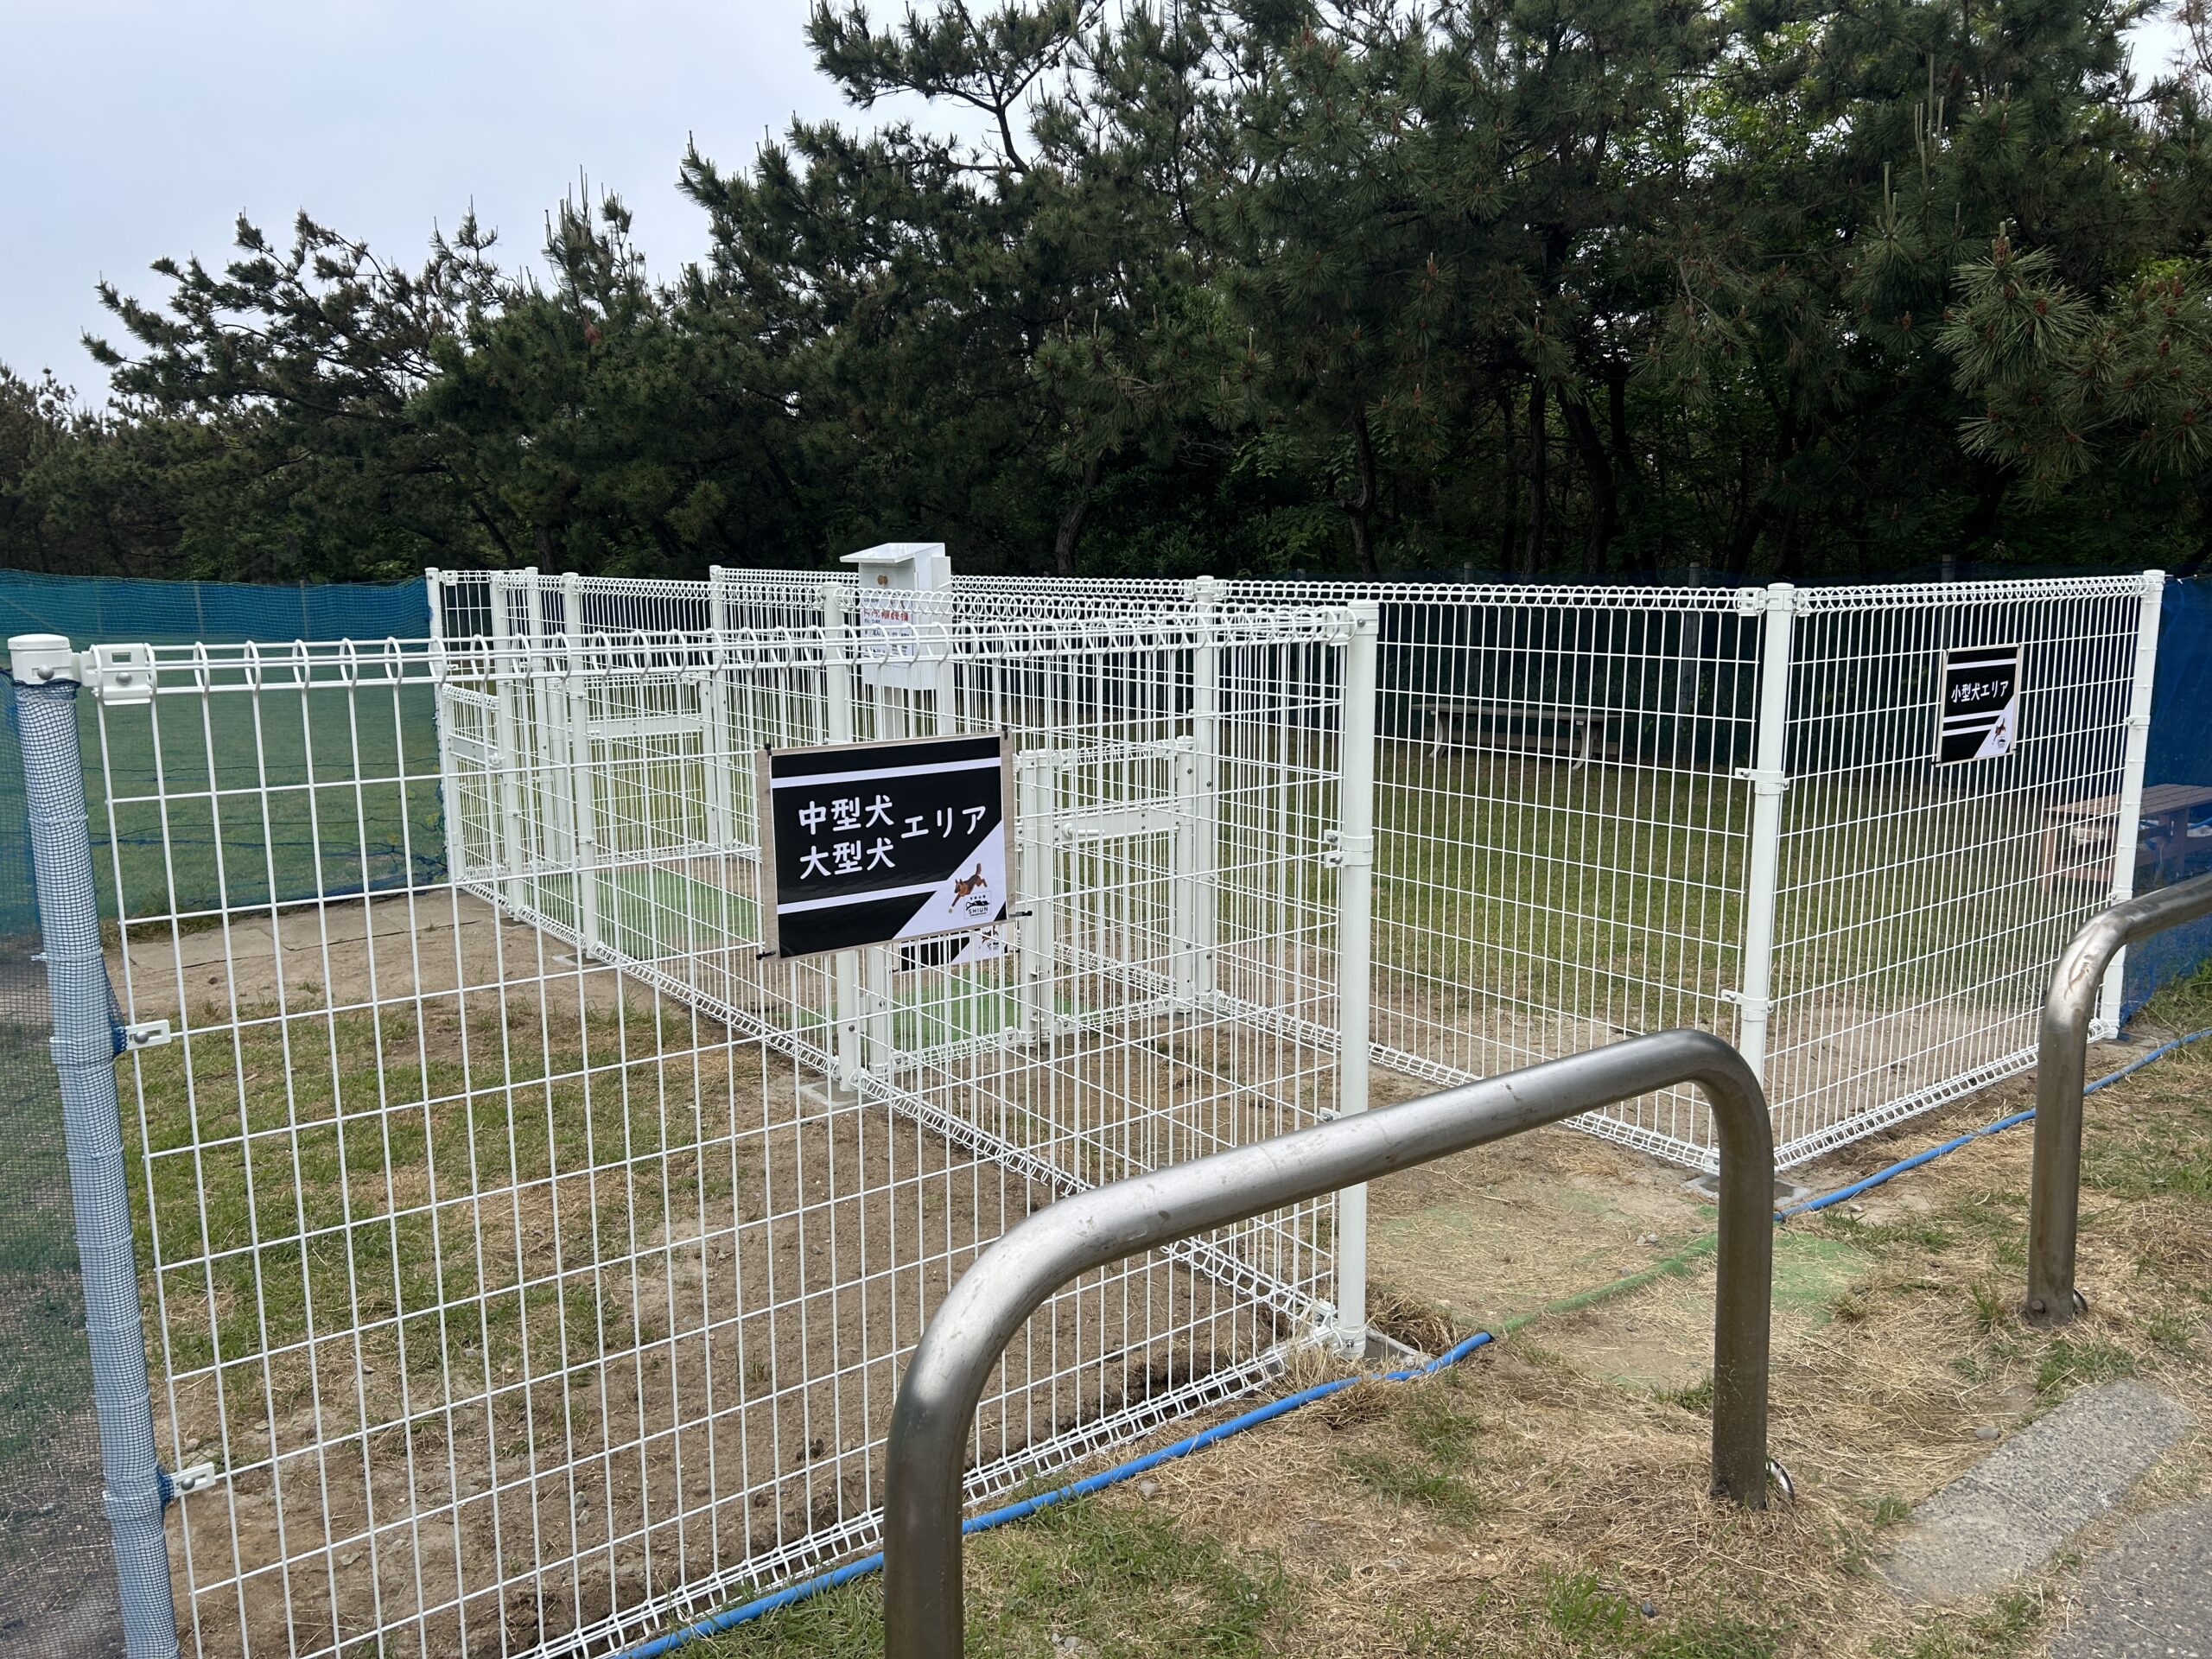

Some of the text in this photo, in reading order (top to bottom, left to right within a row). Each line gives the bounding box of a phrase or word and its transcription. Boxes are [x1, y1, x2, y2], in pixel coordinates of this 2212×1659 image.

[1951, 680, 2009, 703] 小型犬エリア
[798, 794, 894, 835] 中型犬
[900, 805, 986, 838] エリア
[799, 837, 895, 880] 大型犬
[968, 906, 988, 915] SHIUN
